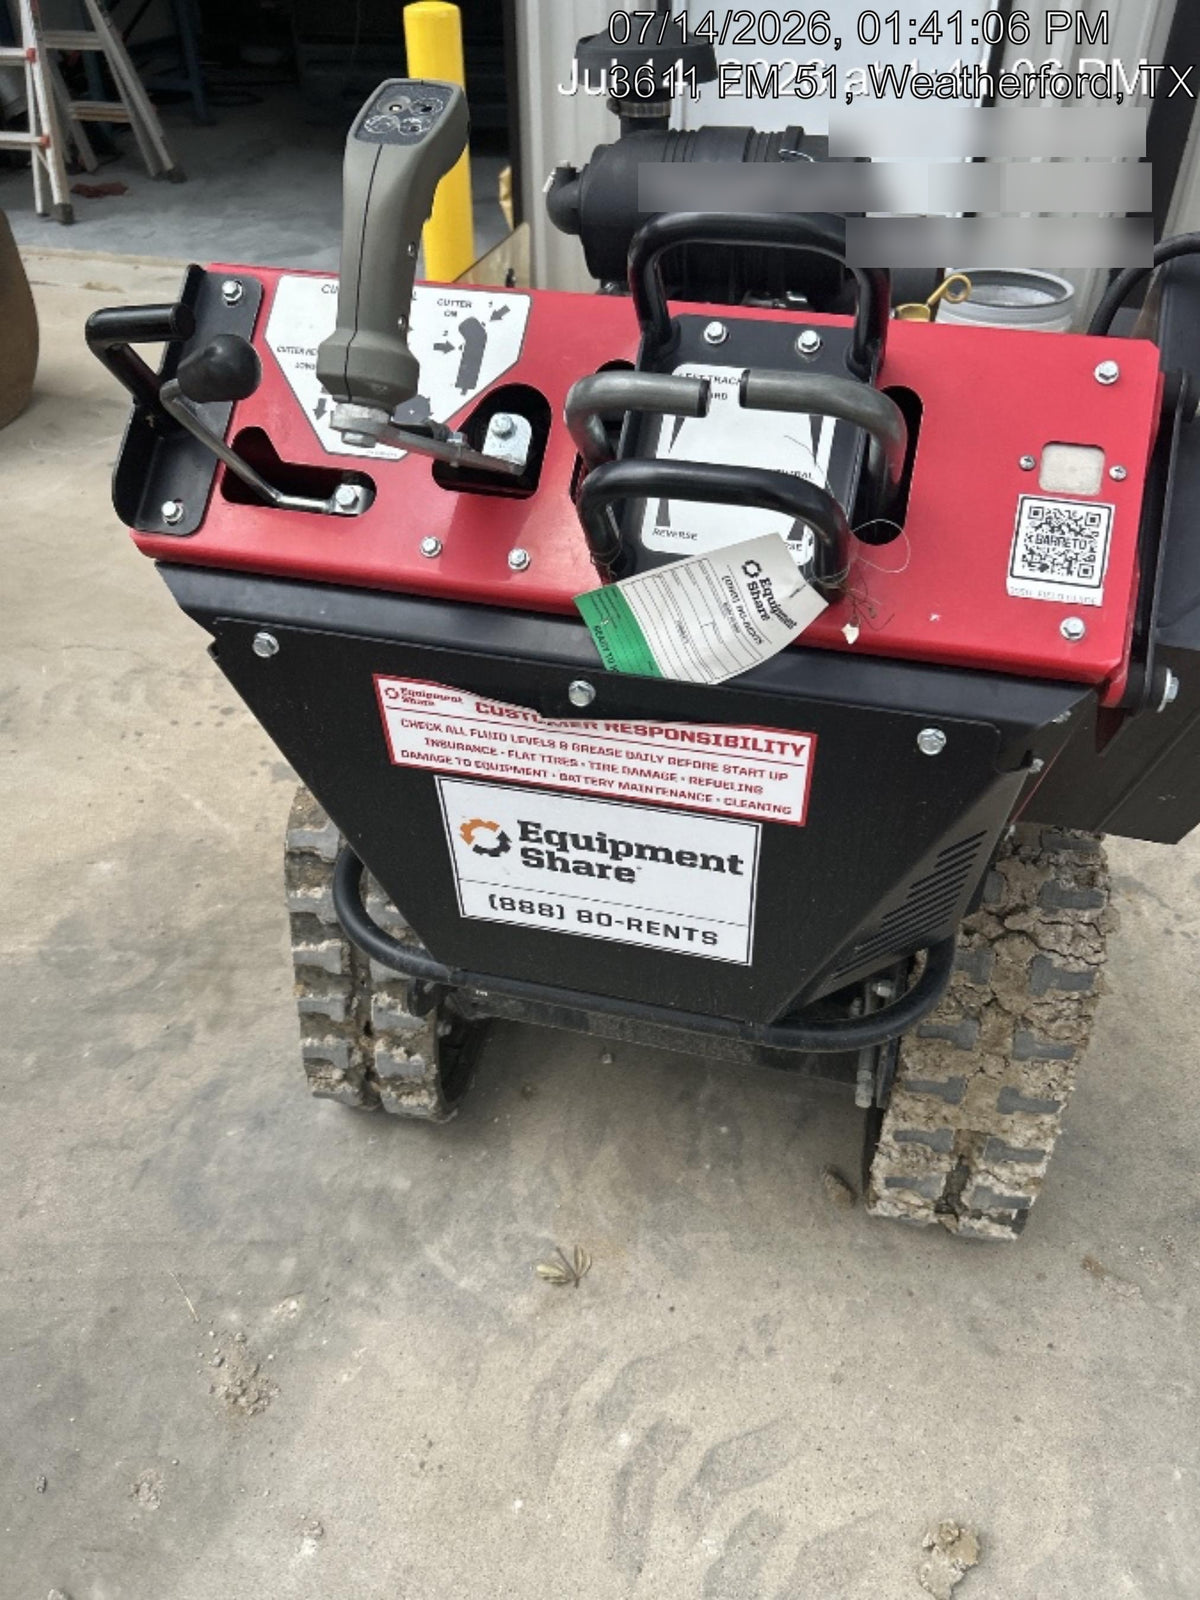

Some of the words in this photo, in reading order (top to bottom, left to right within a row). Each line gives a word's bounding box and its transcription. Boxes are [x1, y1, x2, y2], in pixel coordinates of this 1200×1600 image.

[437, 298, 472, 308] CUTTER
[651, 527, 698, 541] REVERSE
[747, 580, 771, 621] Share
[759, 576, 798, 630] Equipment
[401, 718, 443, 734] CHECK
[446, 725, 468, 737] ALL
[470, 728, 508, 742] FLUID
[511, 733, 556, 749] LEVELS
[572, 742, 623, 758] GREASE
[625, 749, 664, 764] DAILY
[668, 755, 719, 773] BEFORE
[723, 764, 765, 780] START
[769, 771, 789, 782] UP
[424, 737, 498, 756] INSURANCE
[508, 749, 537, 761] FLAT
[541, 754, 579, 768] TIRES
[588, 760, 619, 774] TIRE
[621, 764, 678, 782] DAMAGE
[688, 775, 764, 795] REFUELING
[604, 721, 807, 758] RESPONSIBILITY
[401, 749, 453, 765] DAMAGE
[454, 756, 472, 767] TO
[474, 760, 547, 778] EQUIPMENT
[559, 772, 615, 788] BATTERY
[617, 780, 713, 803] MAINTENANCE
[723, 796, 792, 815] CLEANING
[516, 818, 745, 876] Equipment
[519, 846, 637, 884] Share
[487, 893, 566, 920] (888)
[576, 909, 720, 946] 80-RENTS
